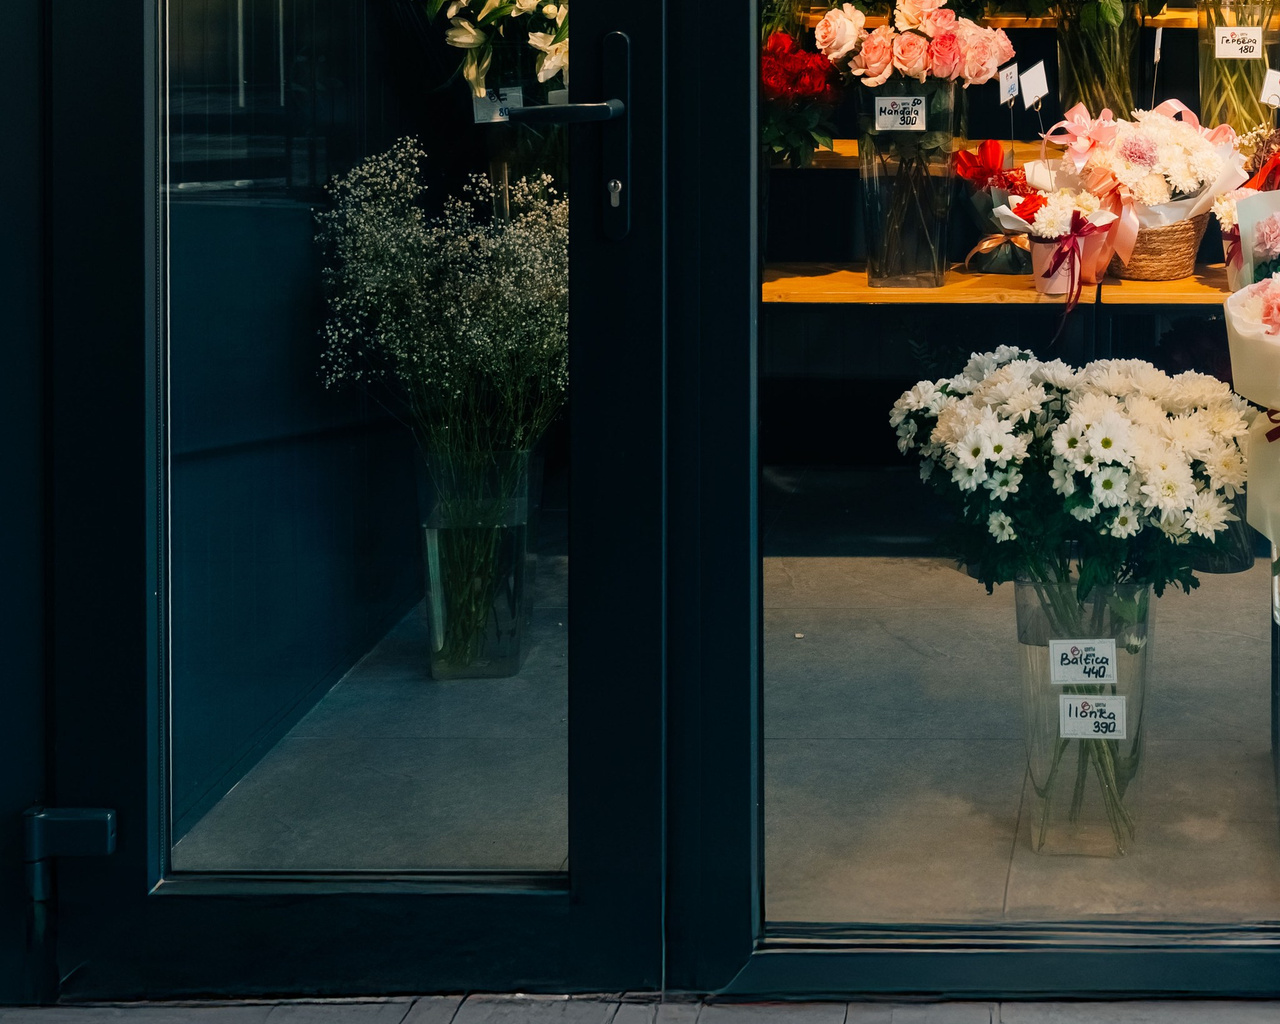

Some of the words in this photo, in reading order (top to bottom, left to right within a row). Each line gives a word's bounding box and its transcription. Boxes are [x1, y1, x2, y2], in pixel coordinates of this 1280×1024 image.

[1239, 45, 1254, 54] 180
[880, 107, 918, 116] Mandala
[1060, 652, 1109, 666] Baltica
[1083, 666, 1106, 678] 440
[1093, 721, 1116, 734] 390
